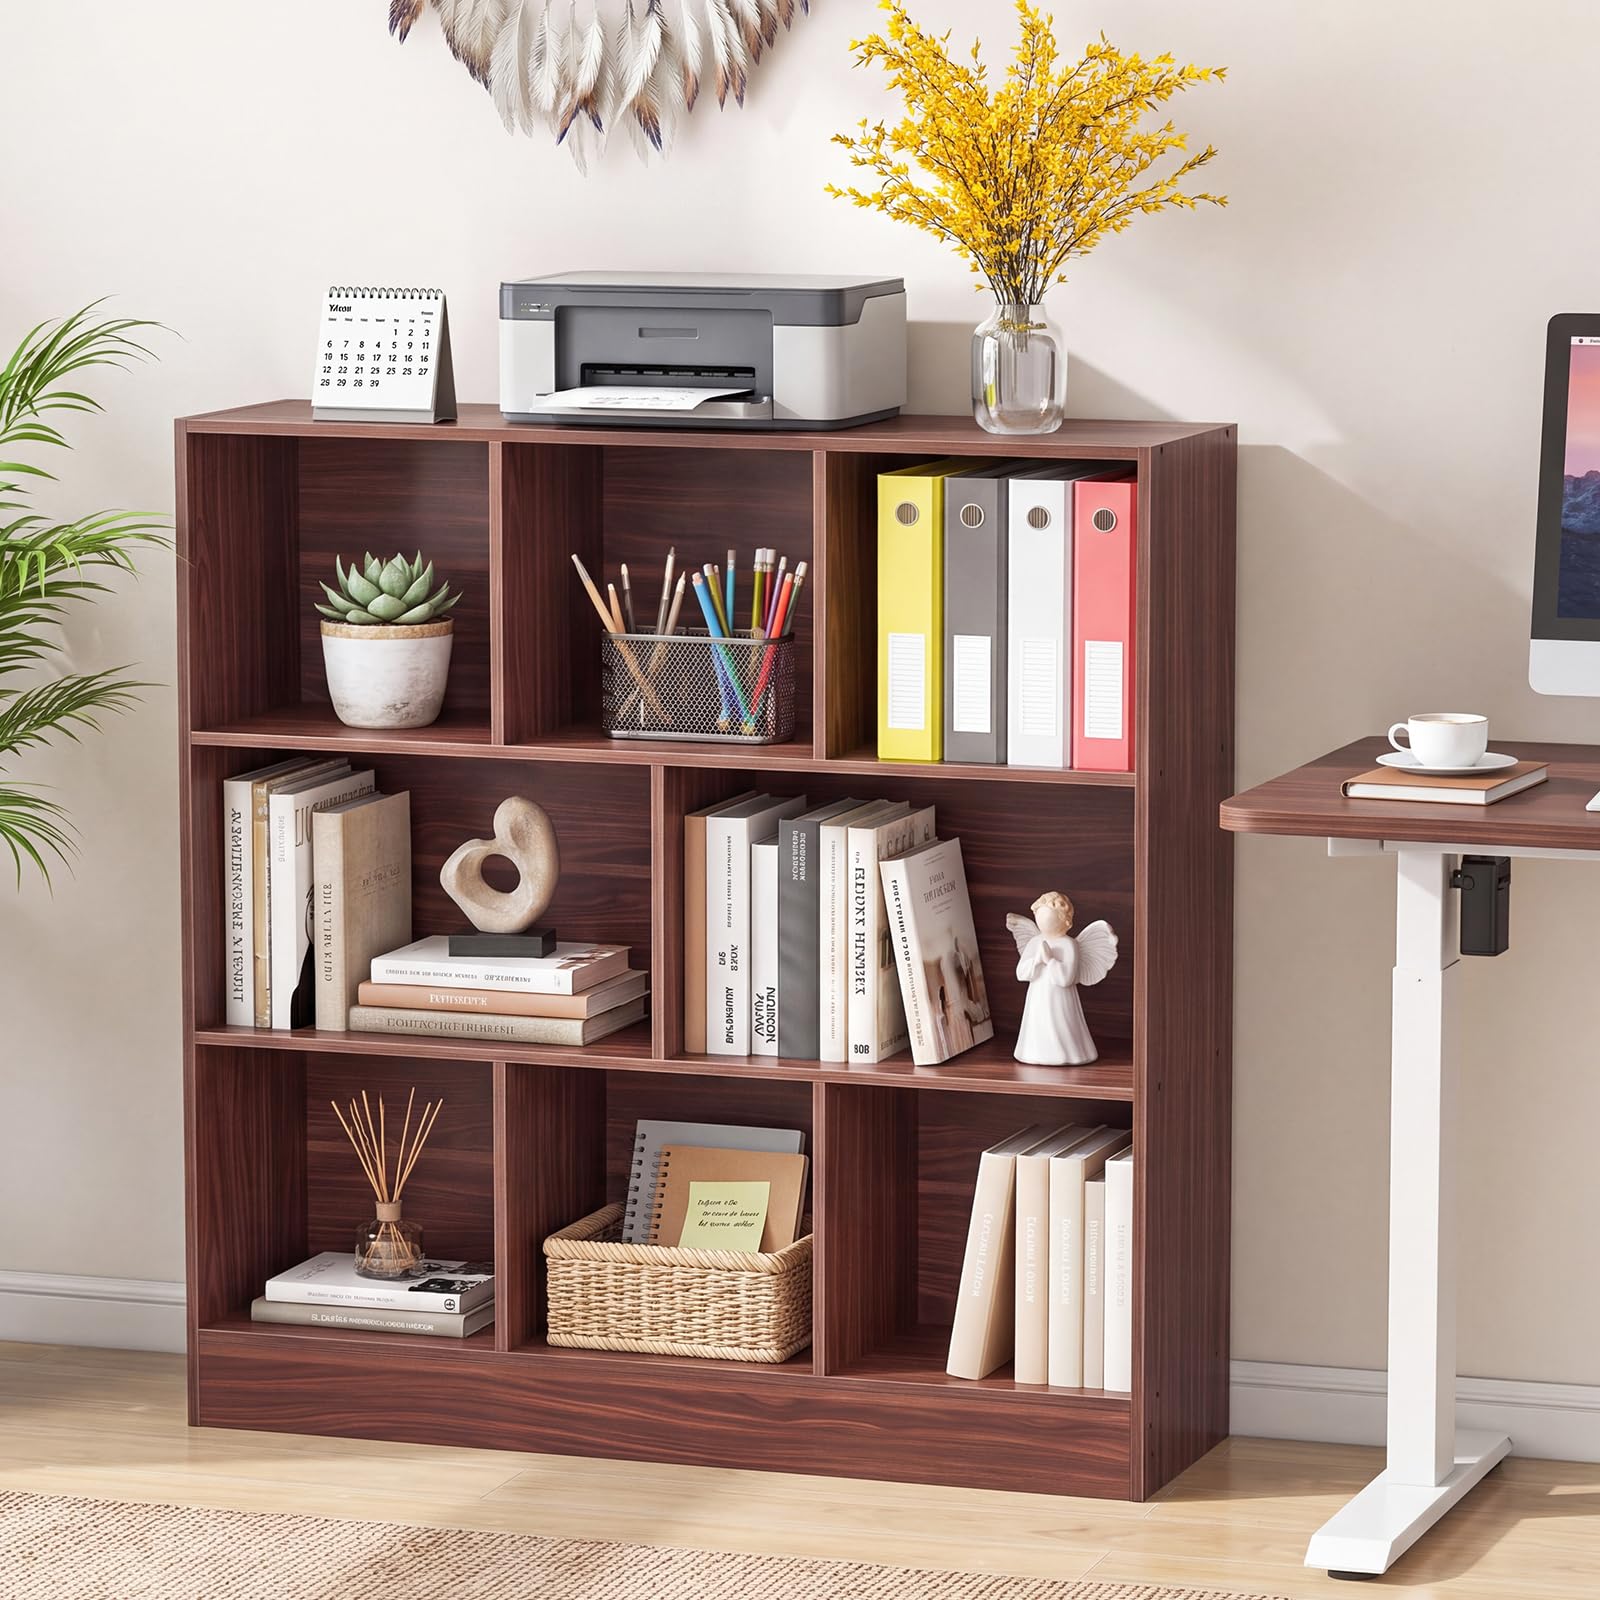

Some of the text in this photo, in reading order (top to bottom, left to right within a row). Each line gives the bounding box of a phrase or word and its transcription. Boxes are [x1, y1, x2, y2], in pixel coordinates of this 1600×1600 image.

[408, 329, 414, 337] 2
[425, 329, 430, 337] 3
[327, 340, 429, 350] 6 7 8 4 5 9 11
[324, 353, 333, 361] 10
[340, 353, 349, 361] 15
[373, 354, 382, 362] 17
[389, 354, 398, 363] 12
[405, 355, 413, 363] 16
[421, 355, 429, 363] 16
[338, 366, 348, 374] 22
[355, 367, 363, 375] 21
[386, 367, 396, 376] 25
[418, 368, 428, 376] 27
[337, 379, 347, 387] 29
